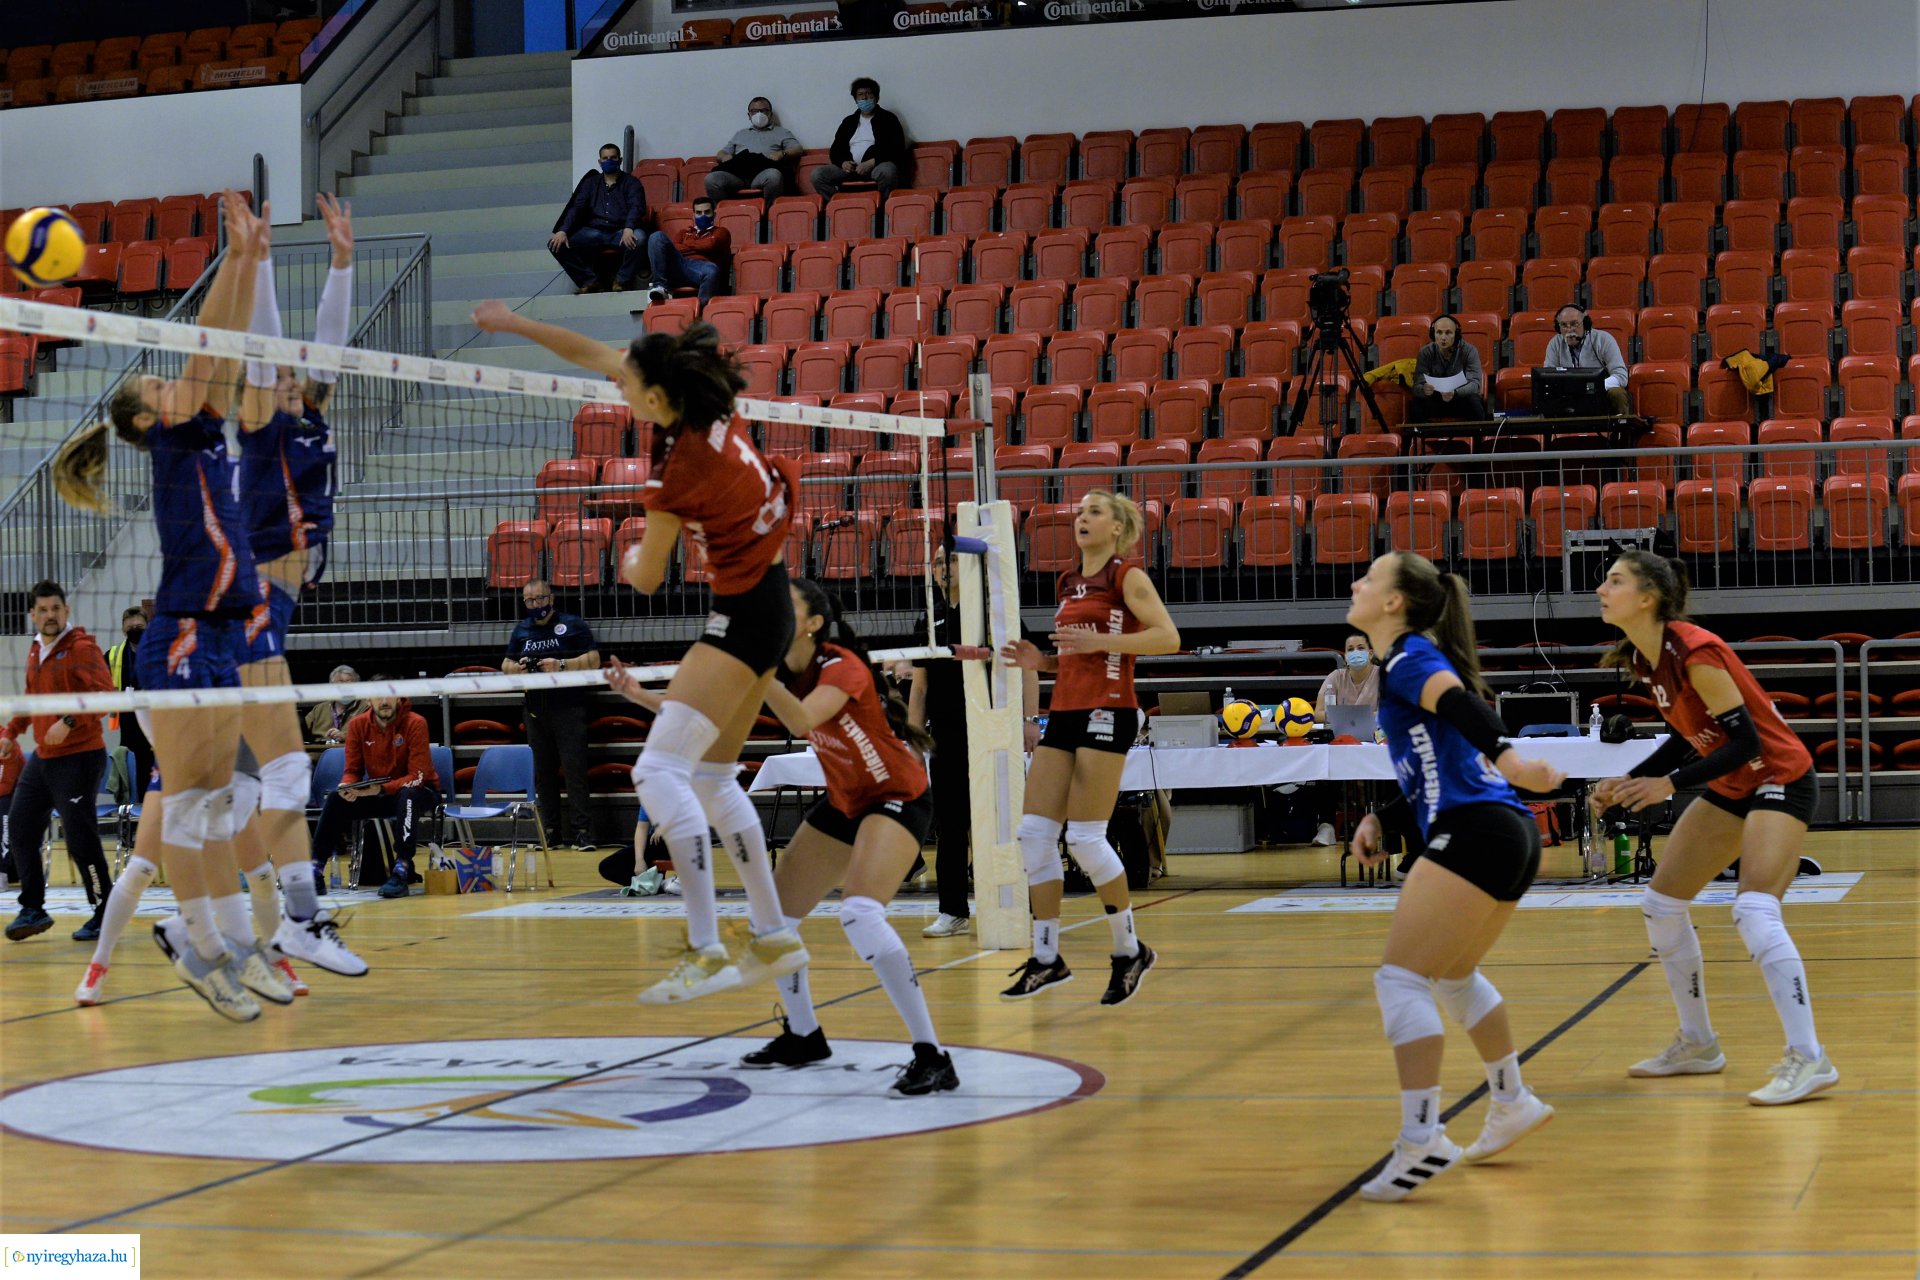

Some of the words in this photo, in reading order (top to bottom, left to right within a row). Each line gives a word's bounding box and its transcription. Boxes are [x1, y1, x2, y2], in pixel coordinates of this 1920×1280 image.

[893, 6, 978, 30] Continental
[1043, 0, 1130, 21] Continental
[603, 28, 684, 51] Continental
[745, 17, 829, 41] Continental
[214, 68, 263, 80] MICHELIN
[1652, 683, 1671, 708] 12
